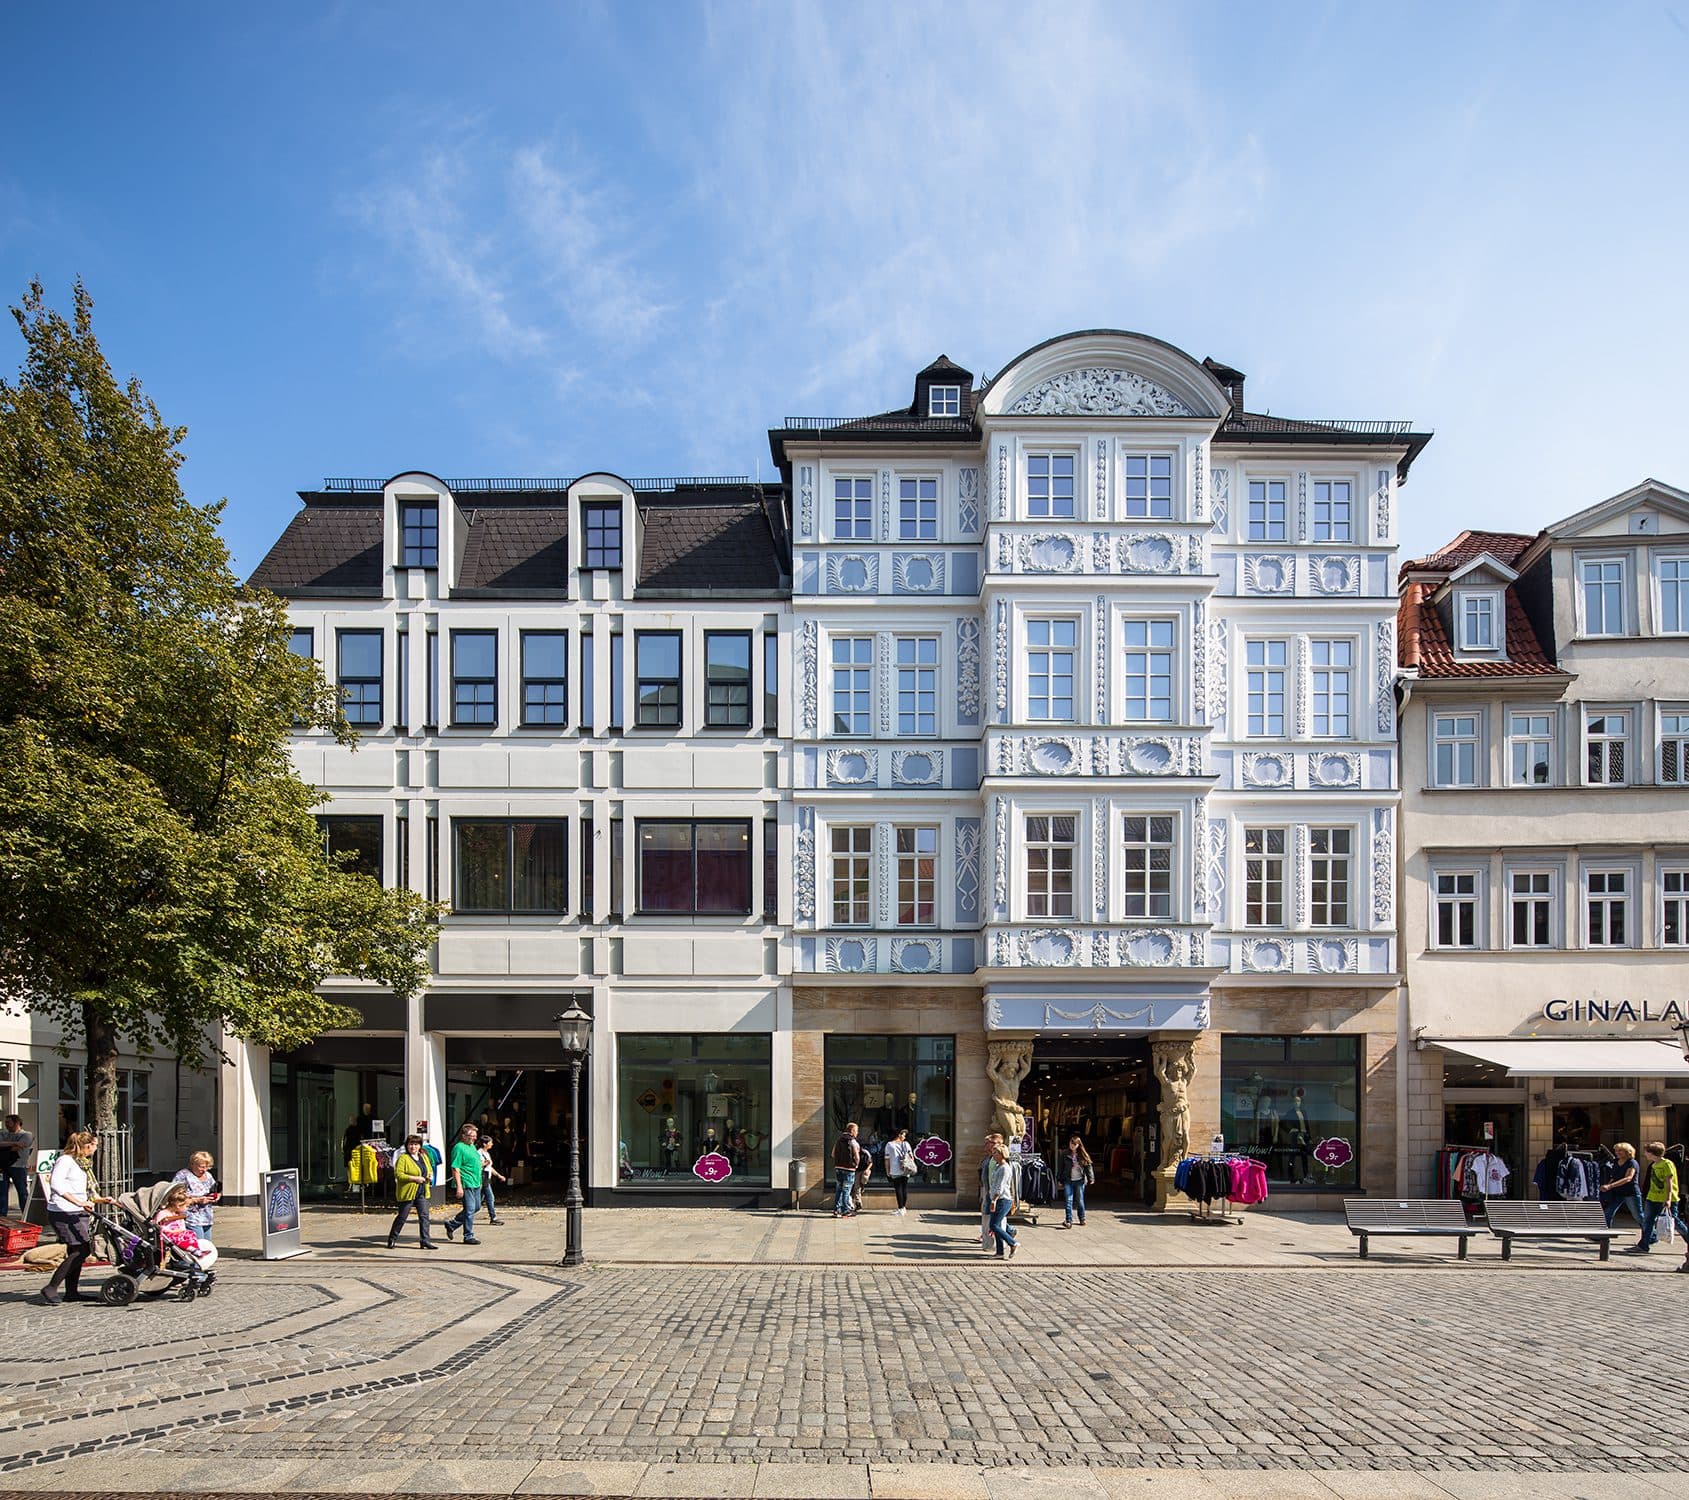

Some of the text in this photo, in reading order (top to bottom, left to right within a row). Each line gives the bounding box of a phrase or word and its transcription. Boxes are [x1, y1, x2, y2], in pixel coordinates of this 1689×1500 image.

[1545, 999, 1689, 1022] GINALA
[1248, 1145, 1273, 1154] Wow!
[642, 1169, 667, 1178] Wow!
